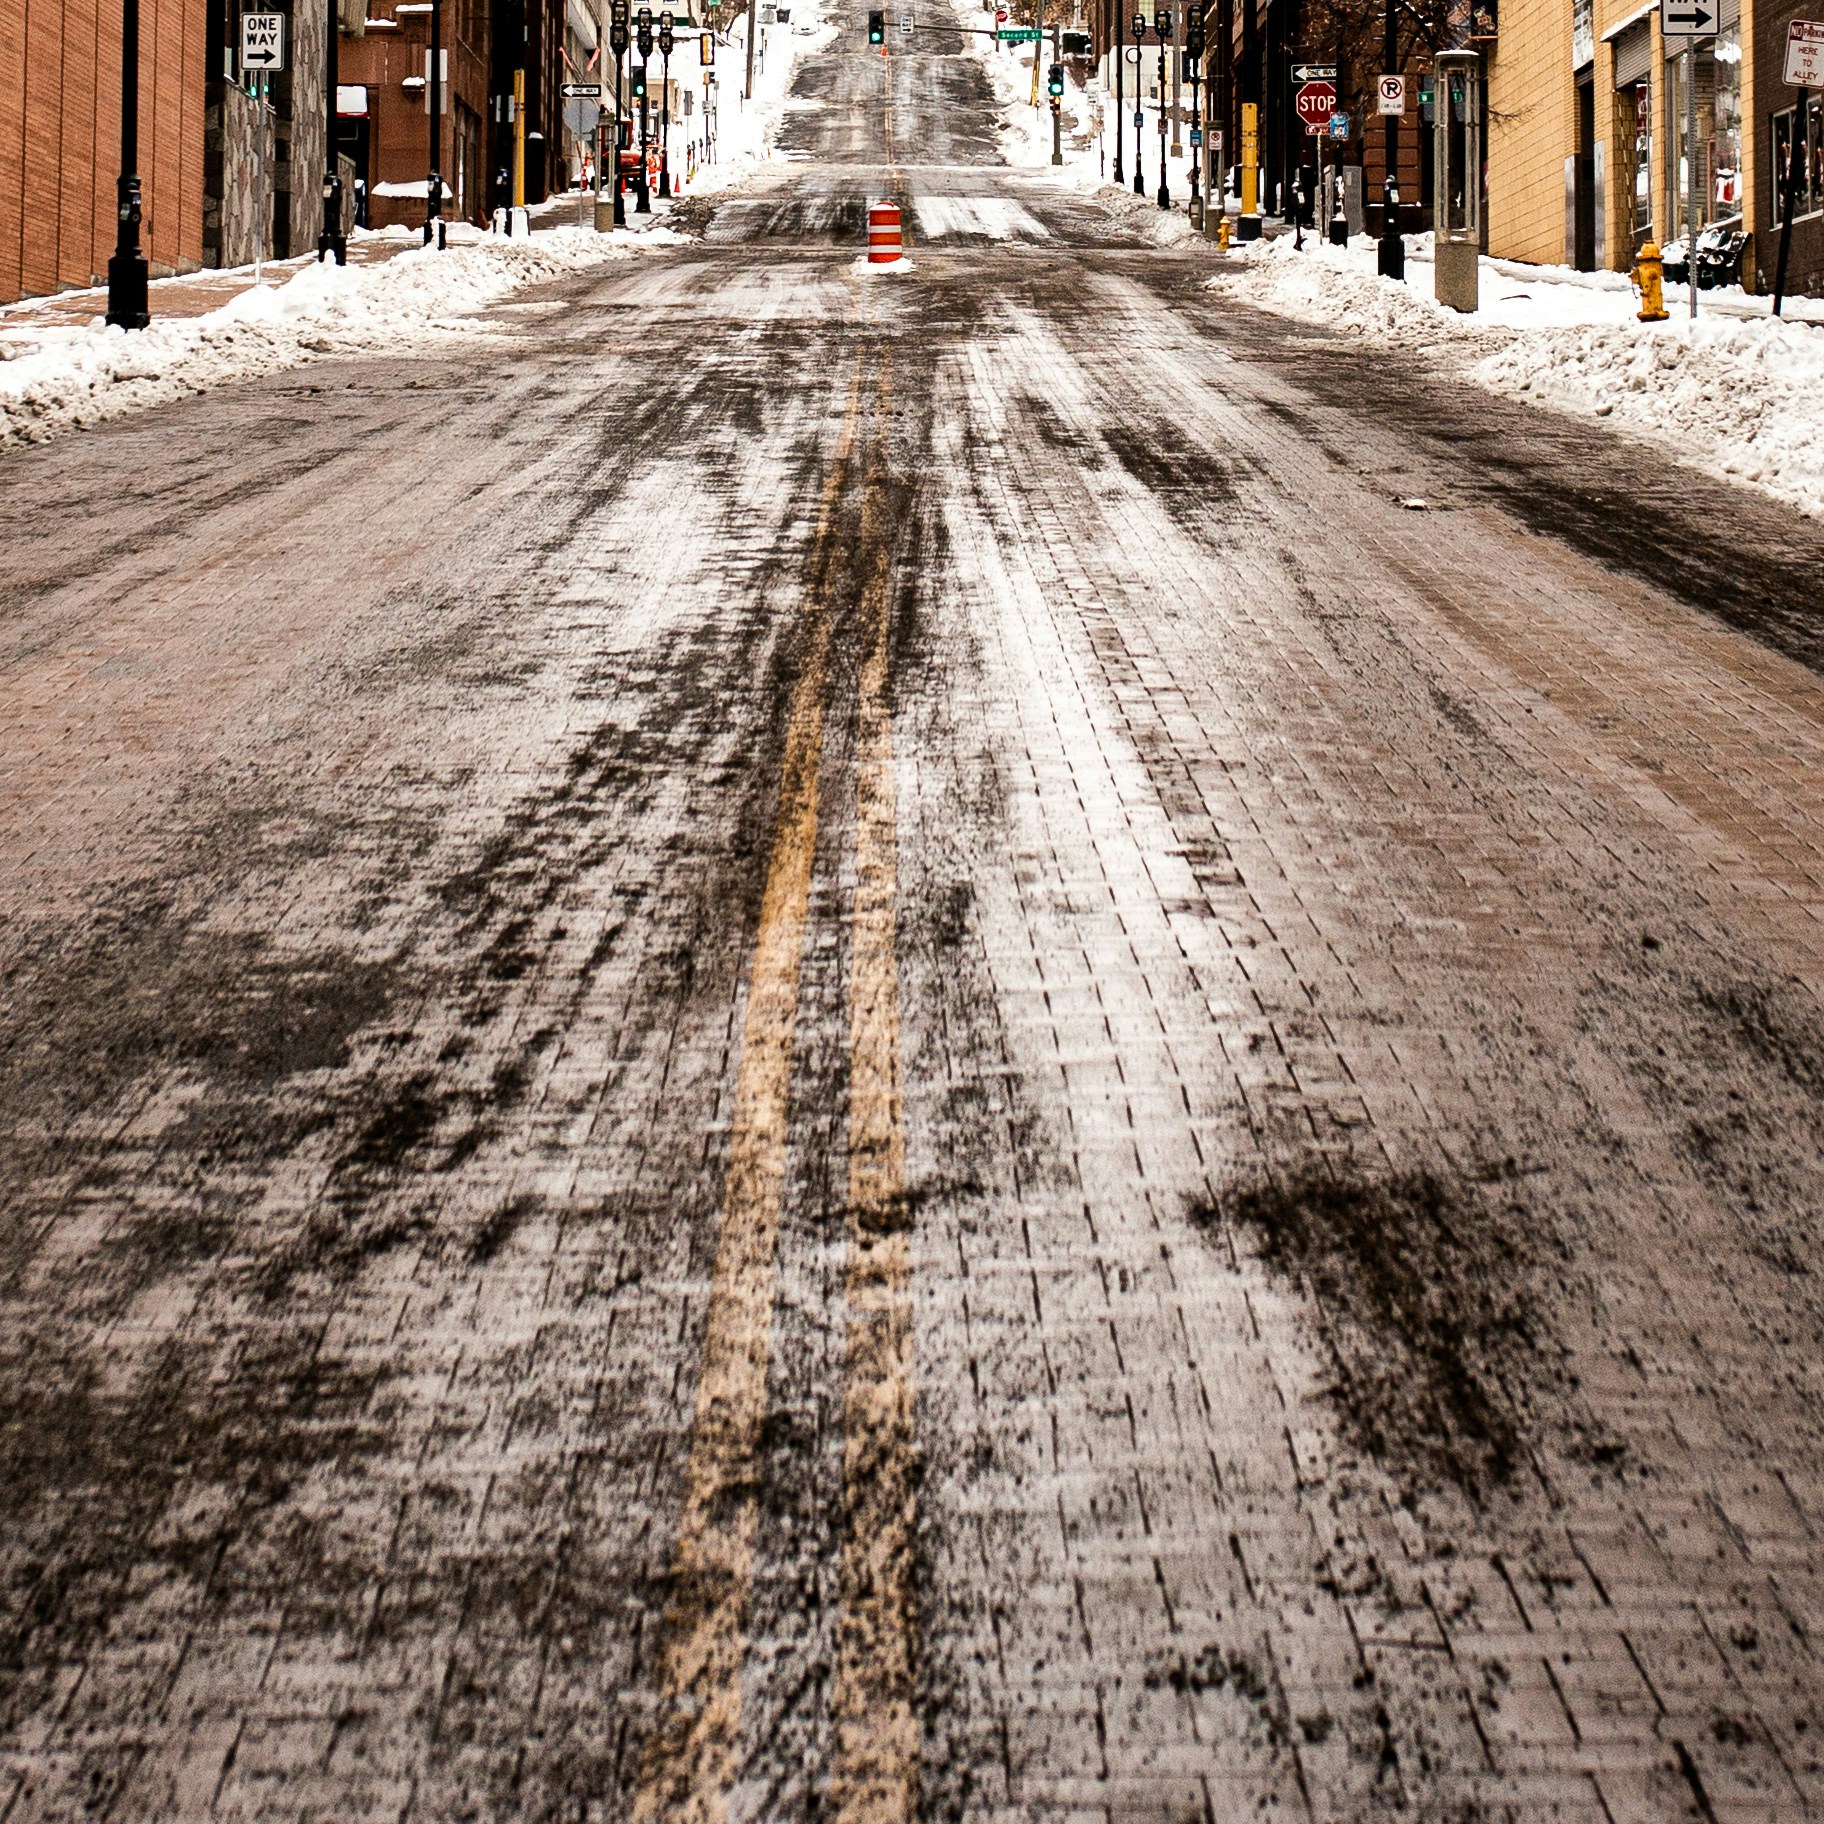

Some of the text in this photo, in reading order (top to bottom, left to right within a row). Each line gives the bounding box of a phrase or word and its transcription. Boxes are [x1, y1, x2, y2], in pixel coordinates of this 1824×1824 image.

[247, 17, 277, 31] ONE
[1001, 31, 1040, 39] Second St
[1790, 24, 1804, 38] NO
[246, 32, 278, 46] WAY
[1797, 46, 1819, 56] HERE
[1802, 58, 1813, 68] TO
[1307, 69, 1321, 78] ONE
[1792, 69, 1819, 81] ALLEY
[1299, 95, 1337, 112] STOP
